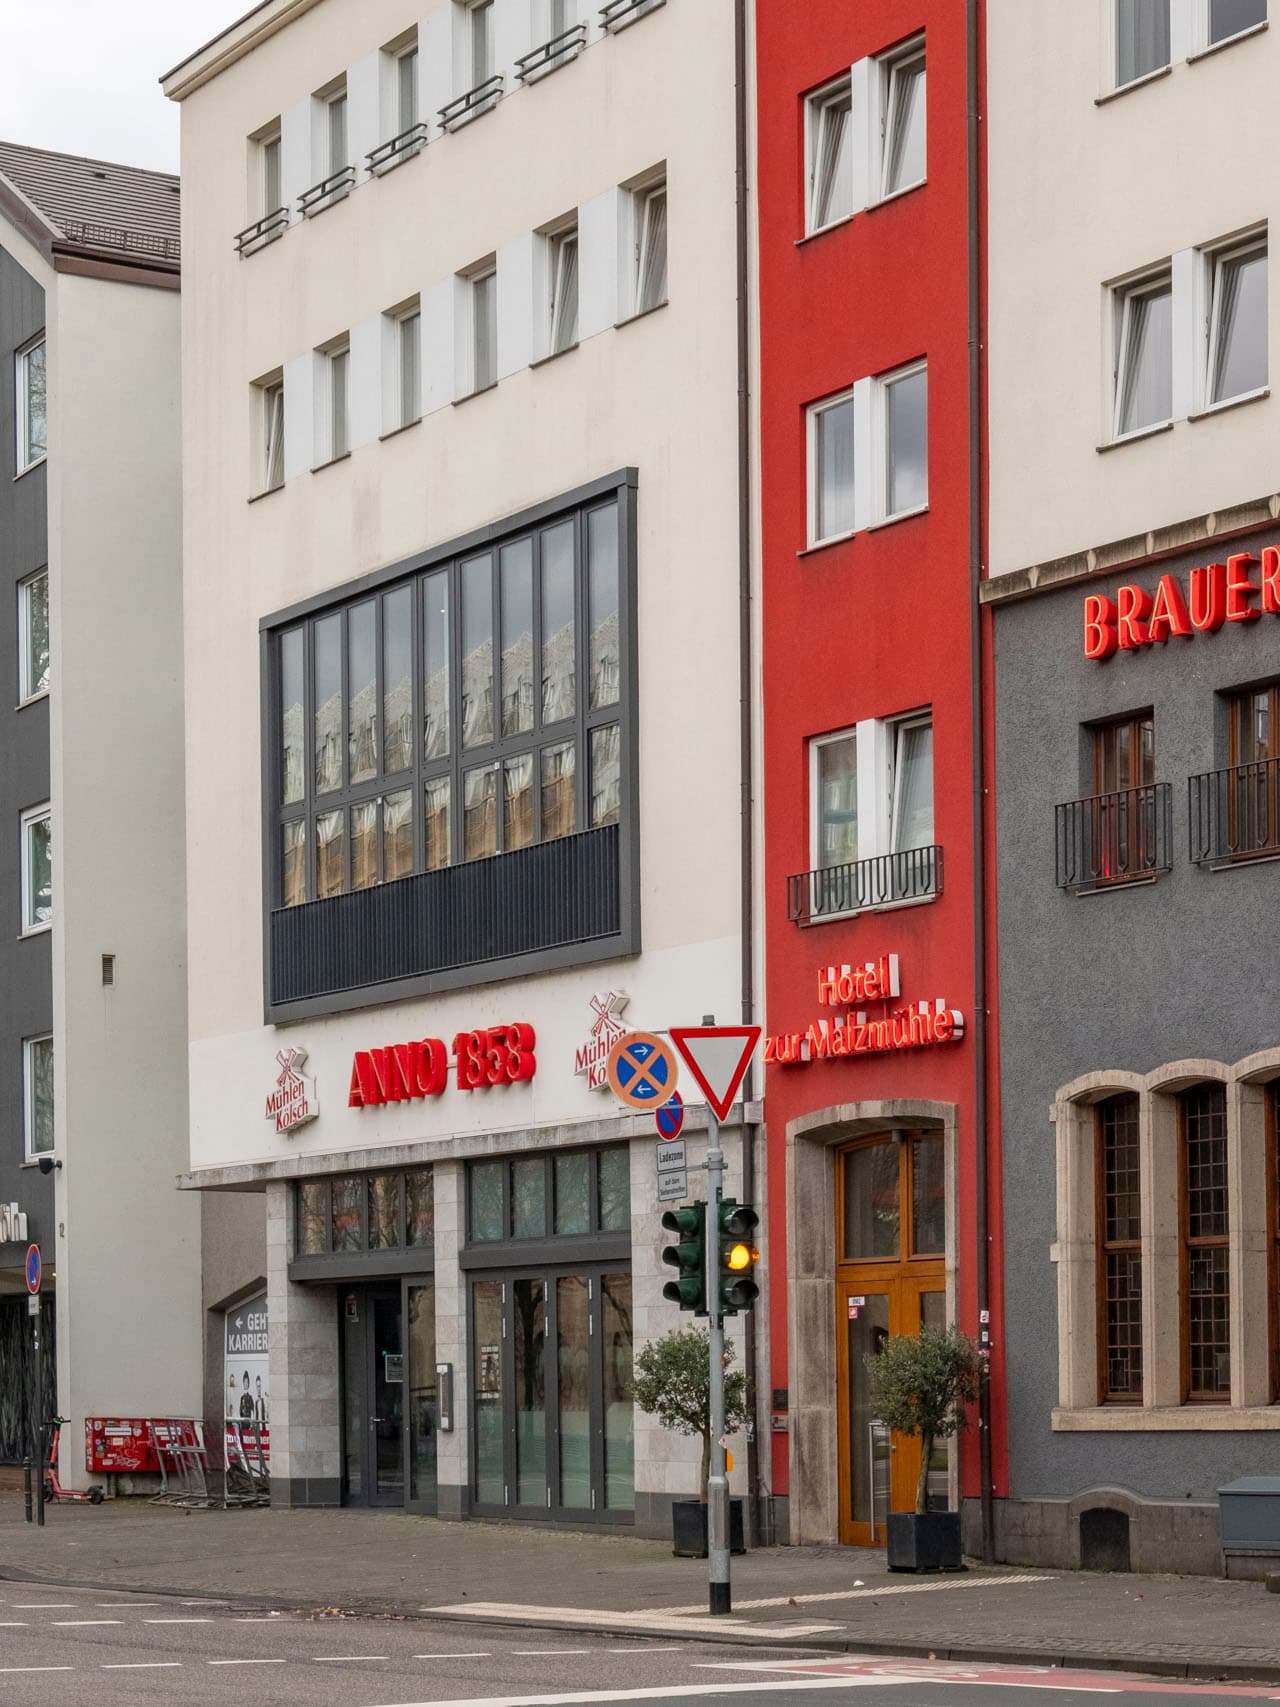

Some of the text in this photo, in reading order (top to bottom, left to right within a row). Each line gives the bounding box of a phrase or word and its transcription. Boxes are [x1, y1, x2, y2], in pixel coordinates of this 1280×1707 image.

[817, 954, 899, 1006] Hotel
[762, 998, 964, 1064] zur Malzmühle
[348, 1038, 448, 1107] ANNO
[452, 1022, 537, 1090] 1858
[265, 1082, 305, 1117] Mühlen
[275, 1097, 309, 1131] Kölsch
[659, 1151, 684, 1163] Ladezone
[247, 1312, 268, 1331] GEH
